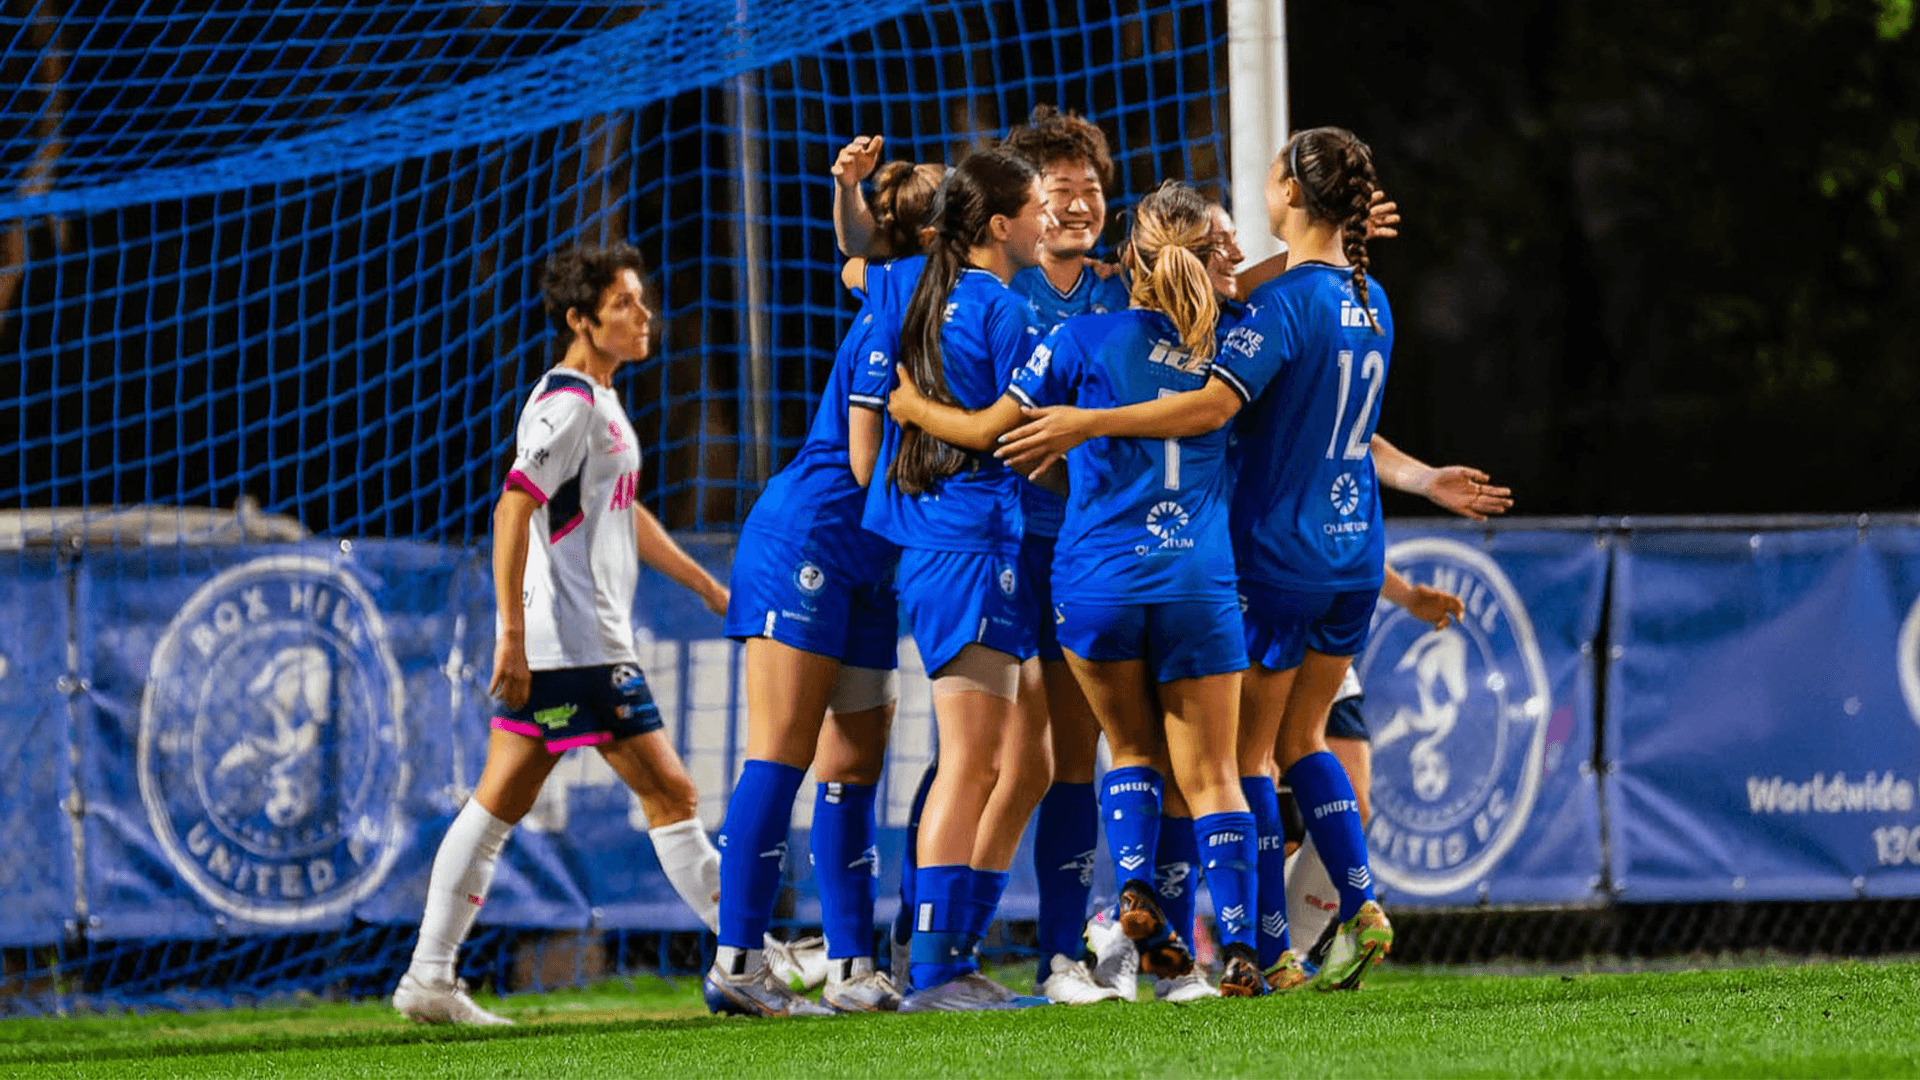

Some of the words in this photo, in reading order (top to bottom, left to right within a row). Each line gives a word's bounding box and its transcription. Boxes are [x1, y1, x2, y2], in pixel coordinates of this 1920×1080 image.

[1326, 350, 1385, 461] 12
[190, 585, 269, 657] BOX
[1745, 770, 1915, 814] Worldwide
[187, 820, 337, 897] UNITED
